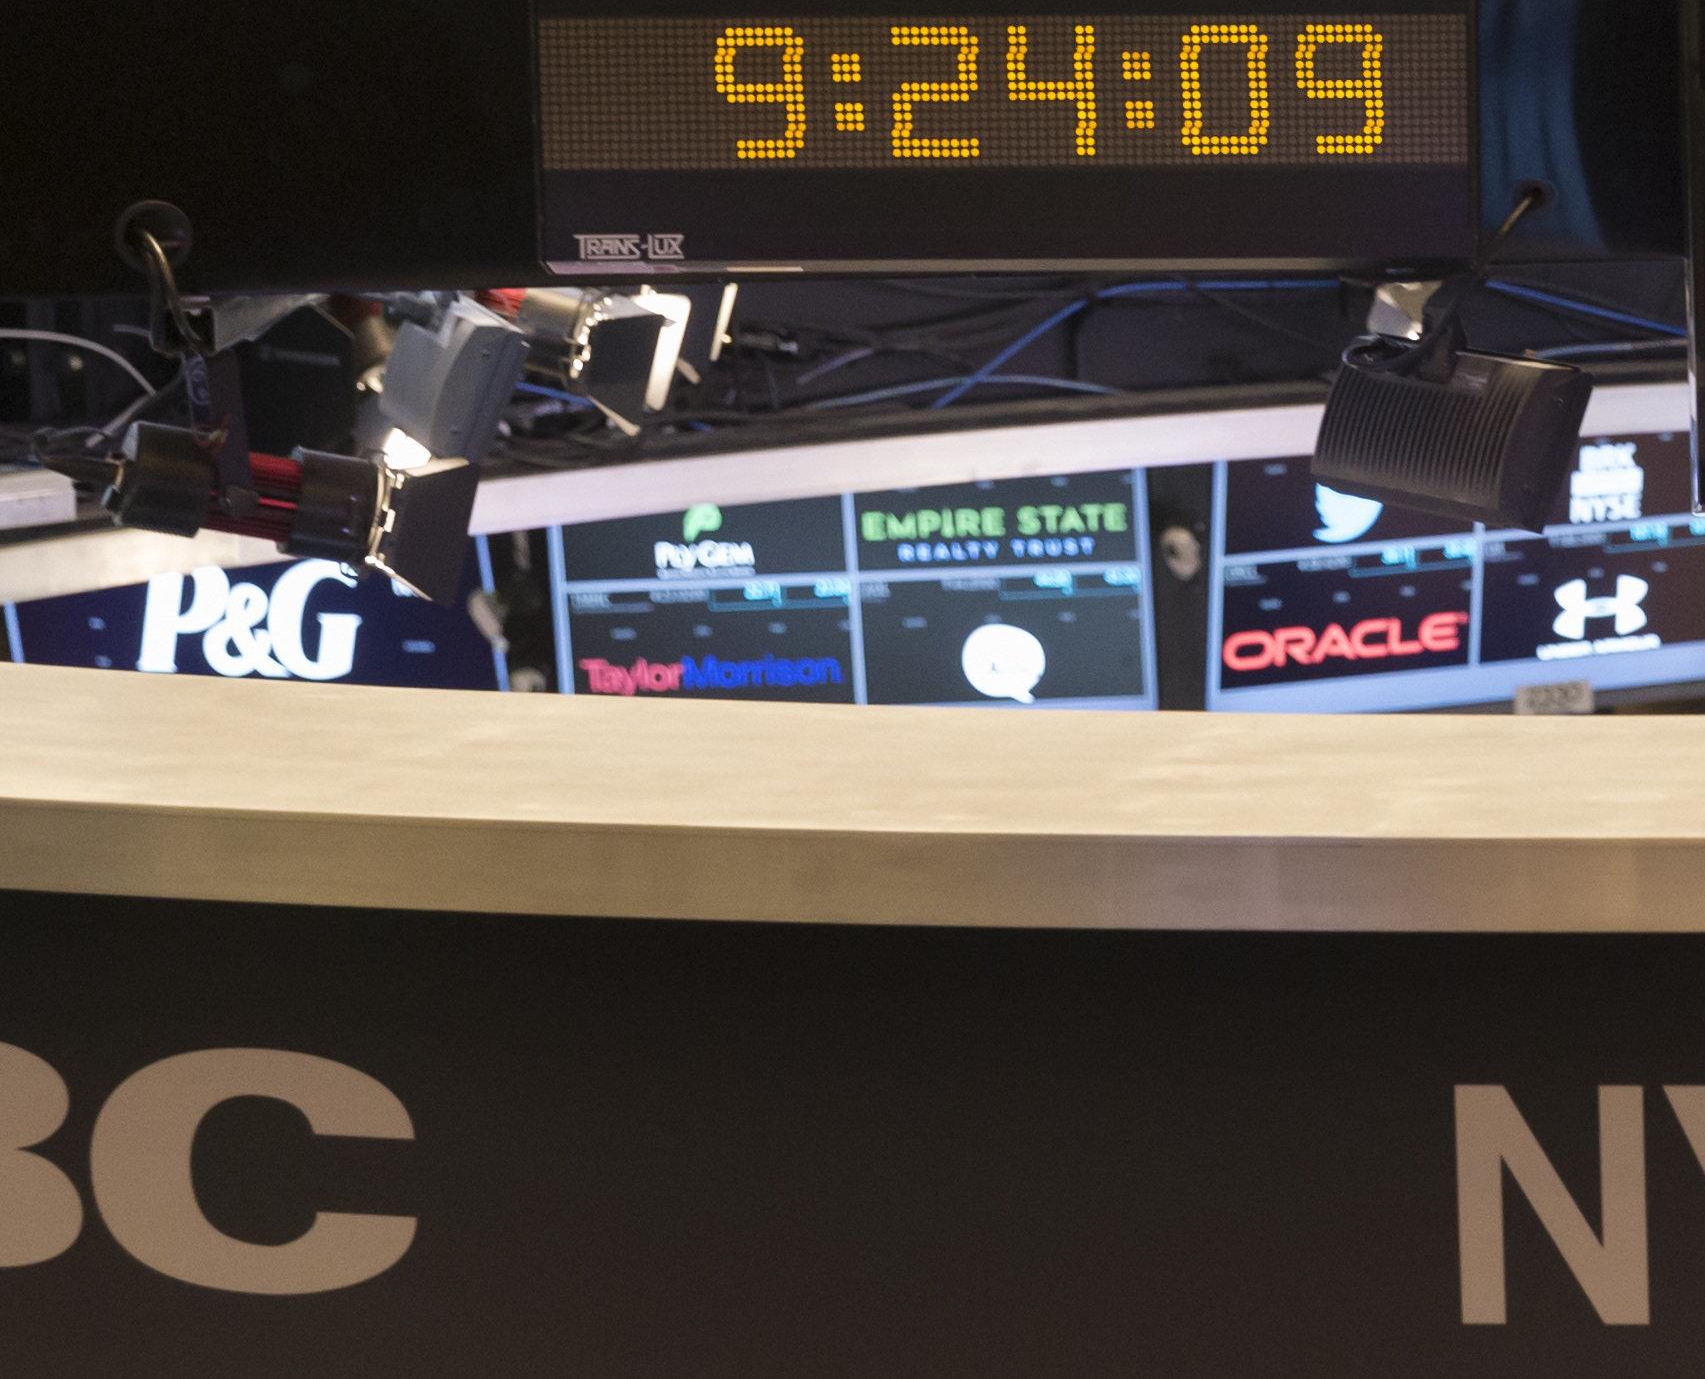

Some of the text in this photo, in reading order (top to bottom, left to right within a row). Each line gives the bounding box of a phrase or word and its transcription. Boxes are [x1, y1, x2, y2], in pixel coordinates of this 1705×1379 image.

[715, 26, 1384, 159] 9:24:09
[573, 234, 685, 259] TRANS-LUX
[862, 503, 1128, 542] EMPIRE STATE
[899, 536, 1095, 562] REALTY TRUST
[138, 558, 362, 681] P&G
[1222, 611, 1468, 671] ORACLE
[0, 1042, 418, 1296] C
